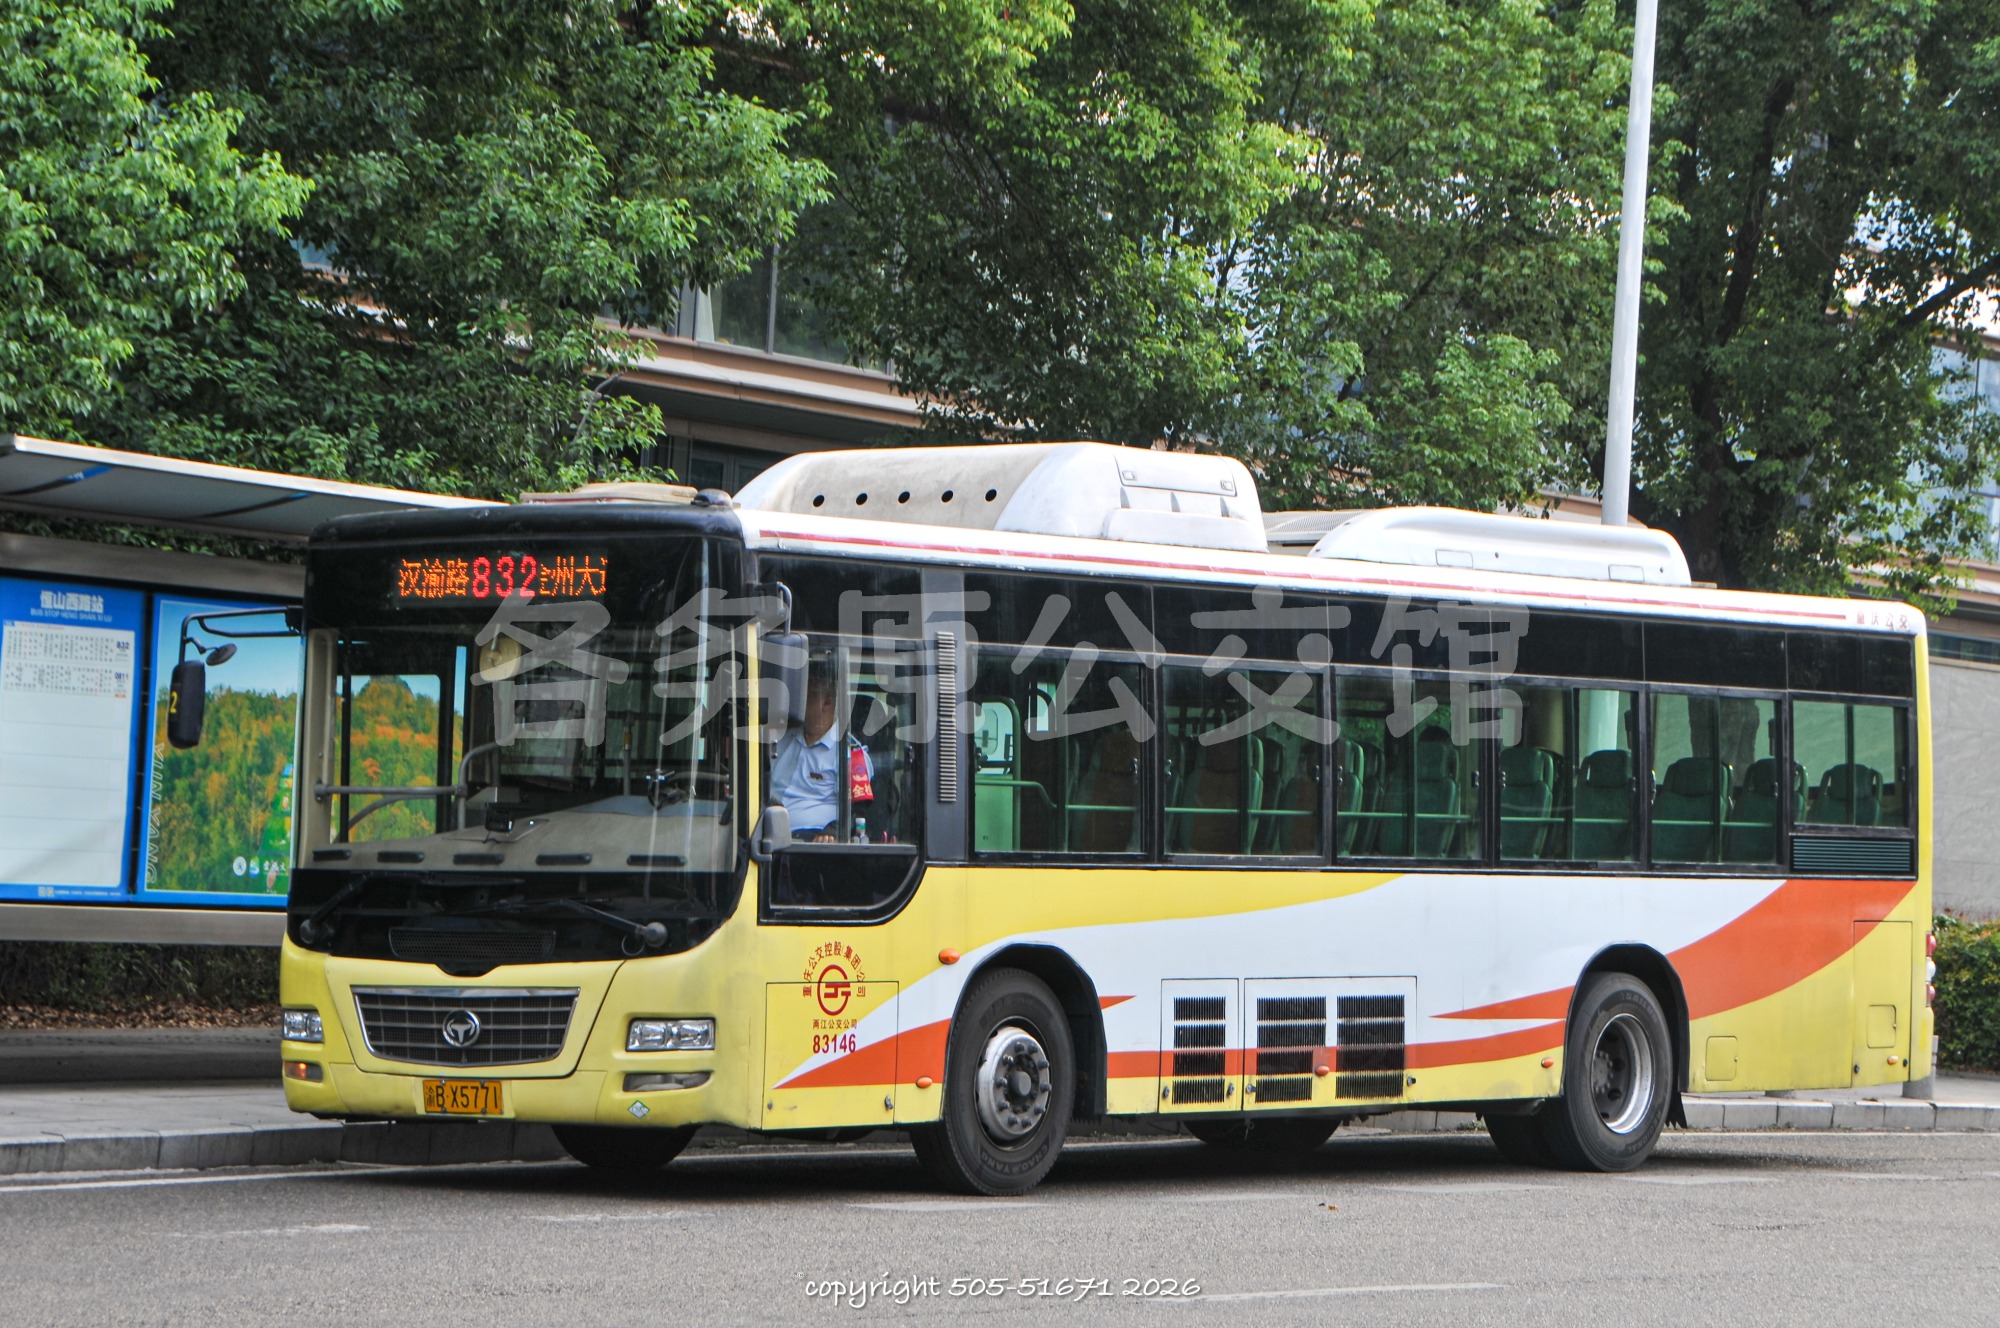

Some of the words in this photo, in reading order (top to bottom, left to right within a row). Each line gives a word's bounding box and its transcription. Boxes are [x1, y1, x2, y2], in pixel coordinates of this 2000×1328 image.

[398, 557, 469, 599] 汉渝路
[472, 555, 537, 599] 832
[812, 1018, 858, 1030] 两江公交公司
[813, 1033, 856, 1054] 83146
